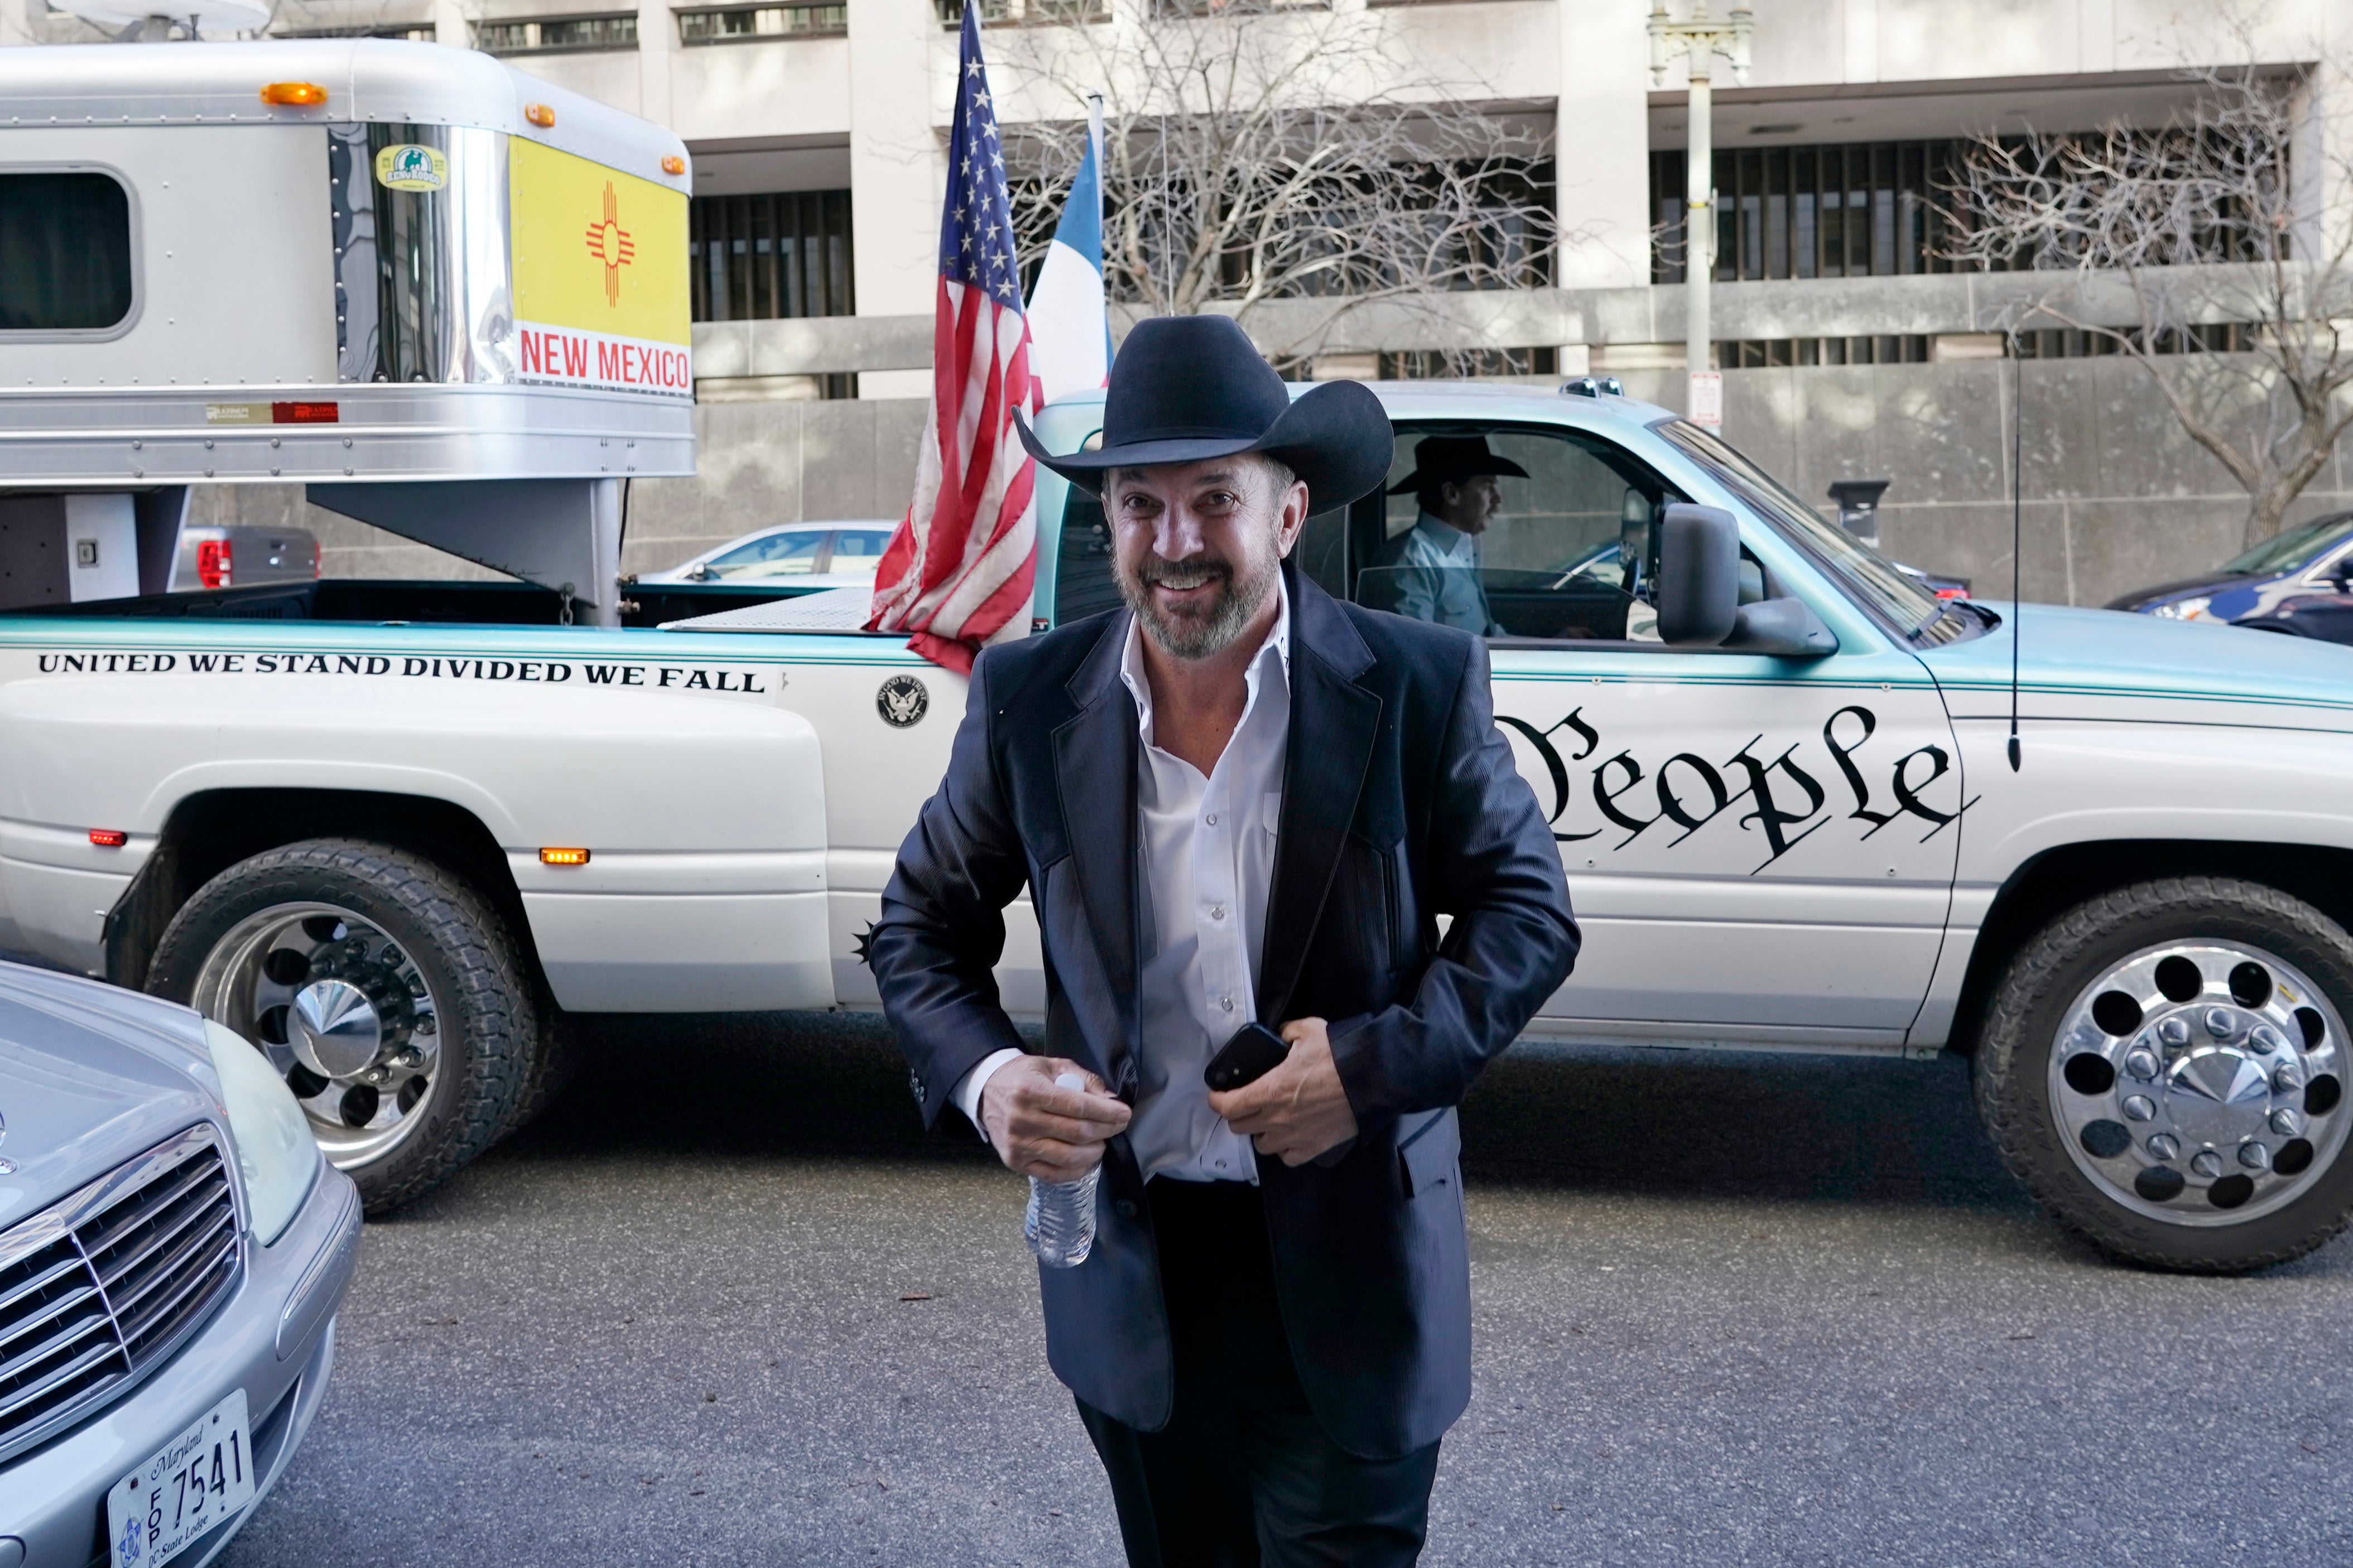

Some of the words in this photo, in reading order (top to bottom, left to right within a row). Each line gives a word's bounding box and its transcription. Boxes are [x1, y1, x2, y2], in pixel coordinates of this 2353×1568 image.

[521, 330, 588, 378] NEW
[598, 341, 688, 388] MEXICO
[39, 654, 176, 673] UNITED
[188, 654, 245, 673] WE
[256, 654, 391, 675] STAND
[402, 658, 571, 682] DIVIDED
[583, 664, 645, 686] WE
[657, 668, 765, 693] FALL
[878, 689, 886, 701] IN
[883, 677, 899, 692] GOD
[899, 676, 913, 685] WE
[911, 680, 927, 701] TRUST
[151, 1424, 204, 1480] Maryland
[173, 1429, 241, 1530] 7541
[148, 1549, 160, 1568] DC
[161, 1536, 183, 1558] State
[185, 1515, 208, 1541] Lodge
